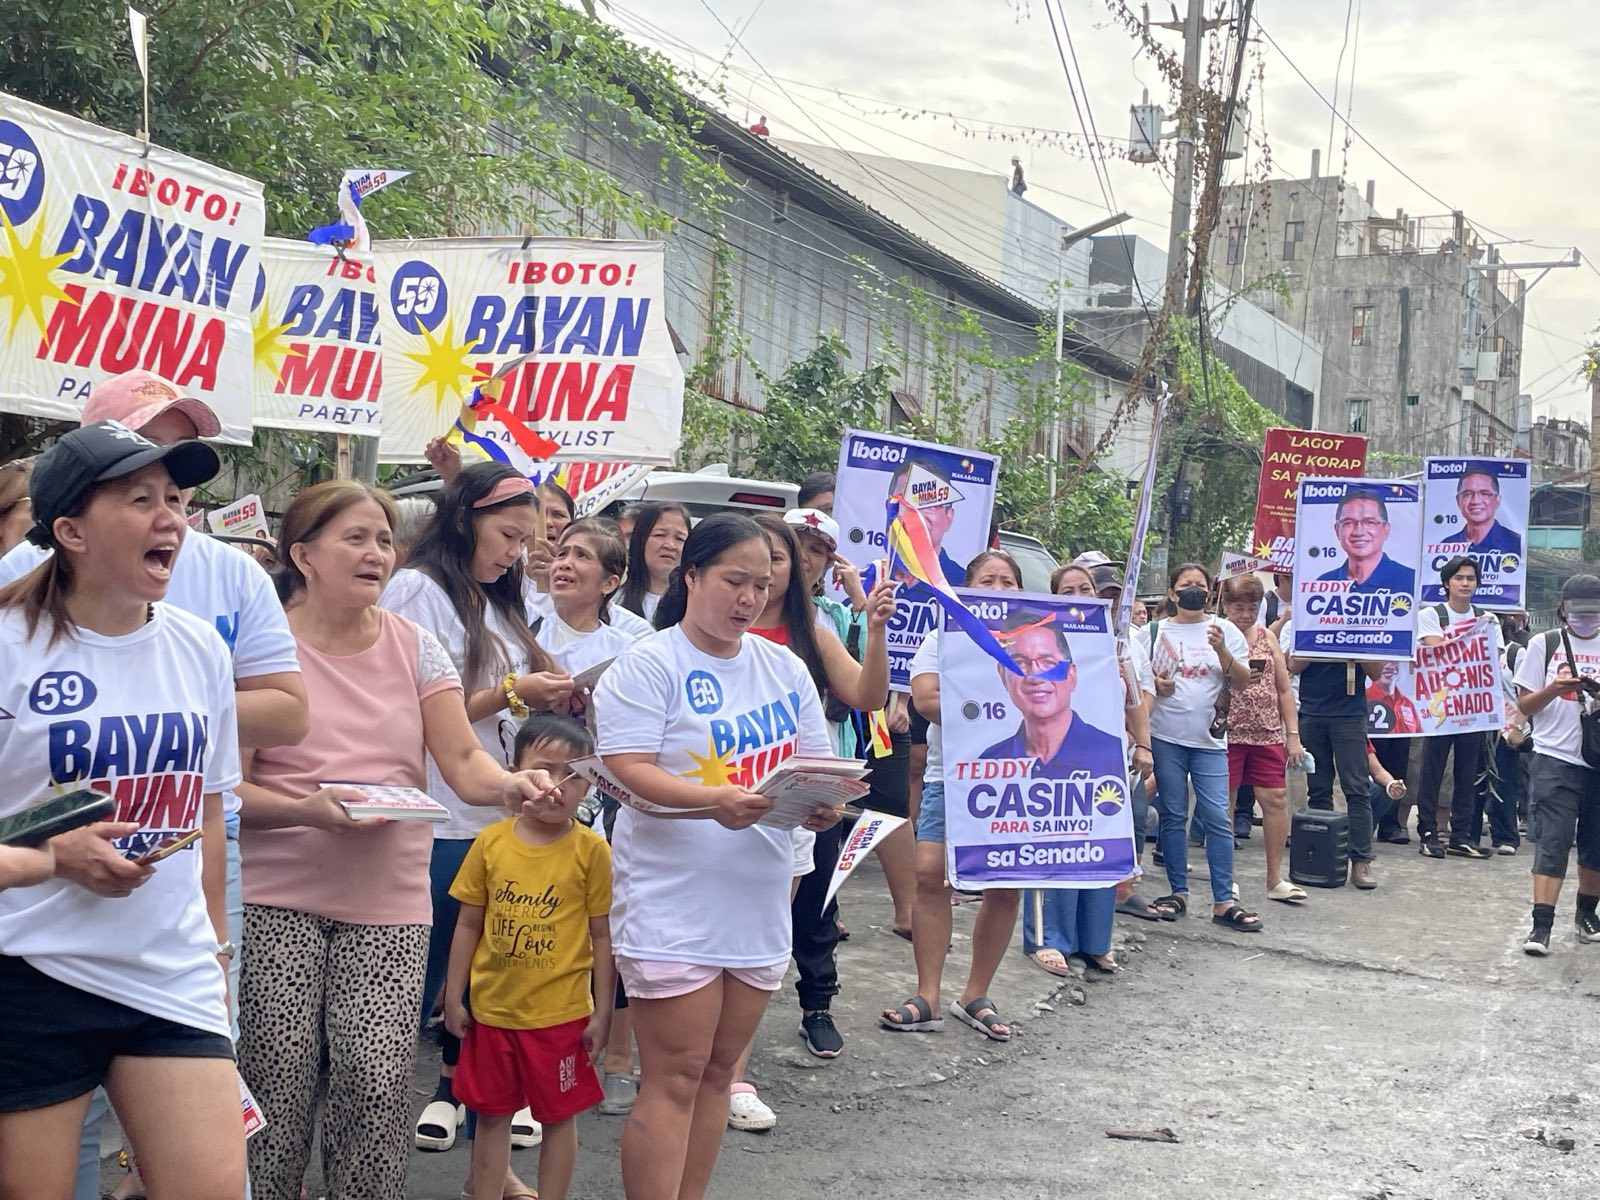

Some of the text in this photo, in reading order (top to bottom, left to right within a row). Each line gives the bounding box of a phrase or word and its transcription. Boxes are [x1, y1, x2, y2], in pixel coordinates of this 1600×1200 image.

[374, 172, 386, 188] 59
[112, 163, 241, 226] IBOTO!
[54, 194, 250, 312] BAYAN
[508, 262, 637, 286] IBOTO!
[397, 276, 440, 316] 59
[464, 295, 651, 357] BAYAN
[36, 282, 226, 392] MUNA
[1290, 436, 1344, 450] LAGOT
[852, 441, 907, 464] Iboto!
[1267, 452, 1361, 469] ANG KORAP
[1271, 469, 1291, 482] SA
[1431, 462, 1467, 474] Iboto!
[912, 481, 937, 495] BAYAN
[938, 486, 949, 502] 59
[1305, 485, 1347, 498] Iboto!
[242, 502, 257, 520] 59
[1446, 515, 1458, 525] 16
[1322, 548, 1337, 558] 16
[1428, 543, 1468, 554] TEDDY
[1301, 582, 1350, 593] TEDDY
[1319, 617, 1388, 626] PARA SA INYO!
[888, 633, 903, 645] SA
[1315, 631, 1393, 645] sa Senado
[1414, 636, 1492, 669] JEROME
[37, 675, 84, 711] 59
[690, 678, 719, 708] 59
[982, 702, 1006, 720] 16
[49, 712, 208, 787] BAYAN
[956, 761, 1032, 780] TEDDY
[859, 820, 882, 849] BAYAN
[990, 819, 1093, 834] PARA SA INYO!
[839, 853, 856, 871] 59
[987, 843, 1105, 868] sa Senado
[495, 879, 562, 919] Family
[492, 919, 515, 937] LIFE
[505, 925, 555, 959] Love
